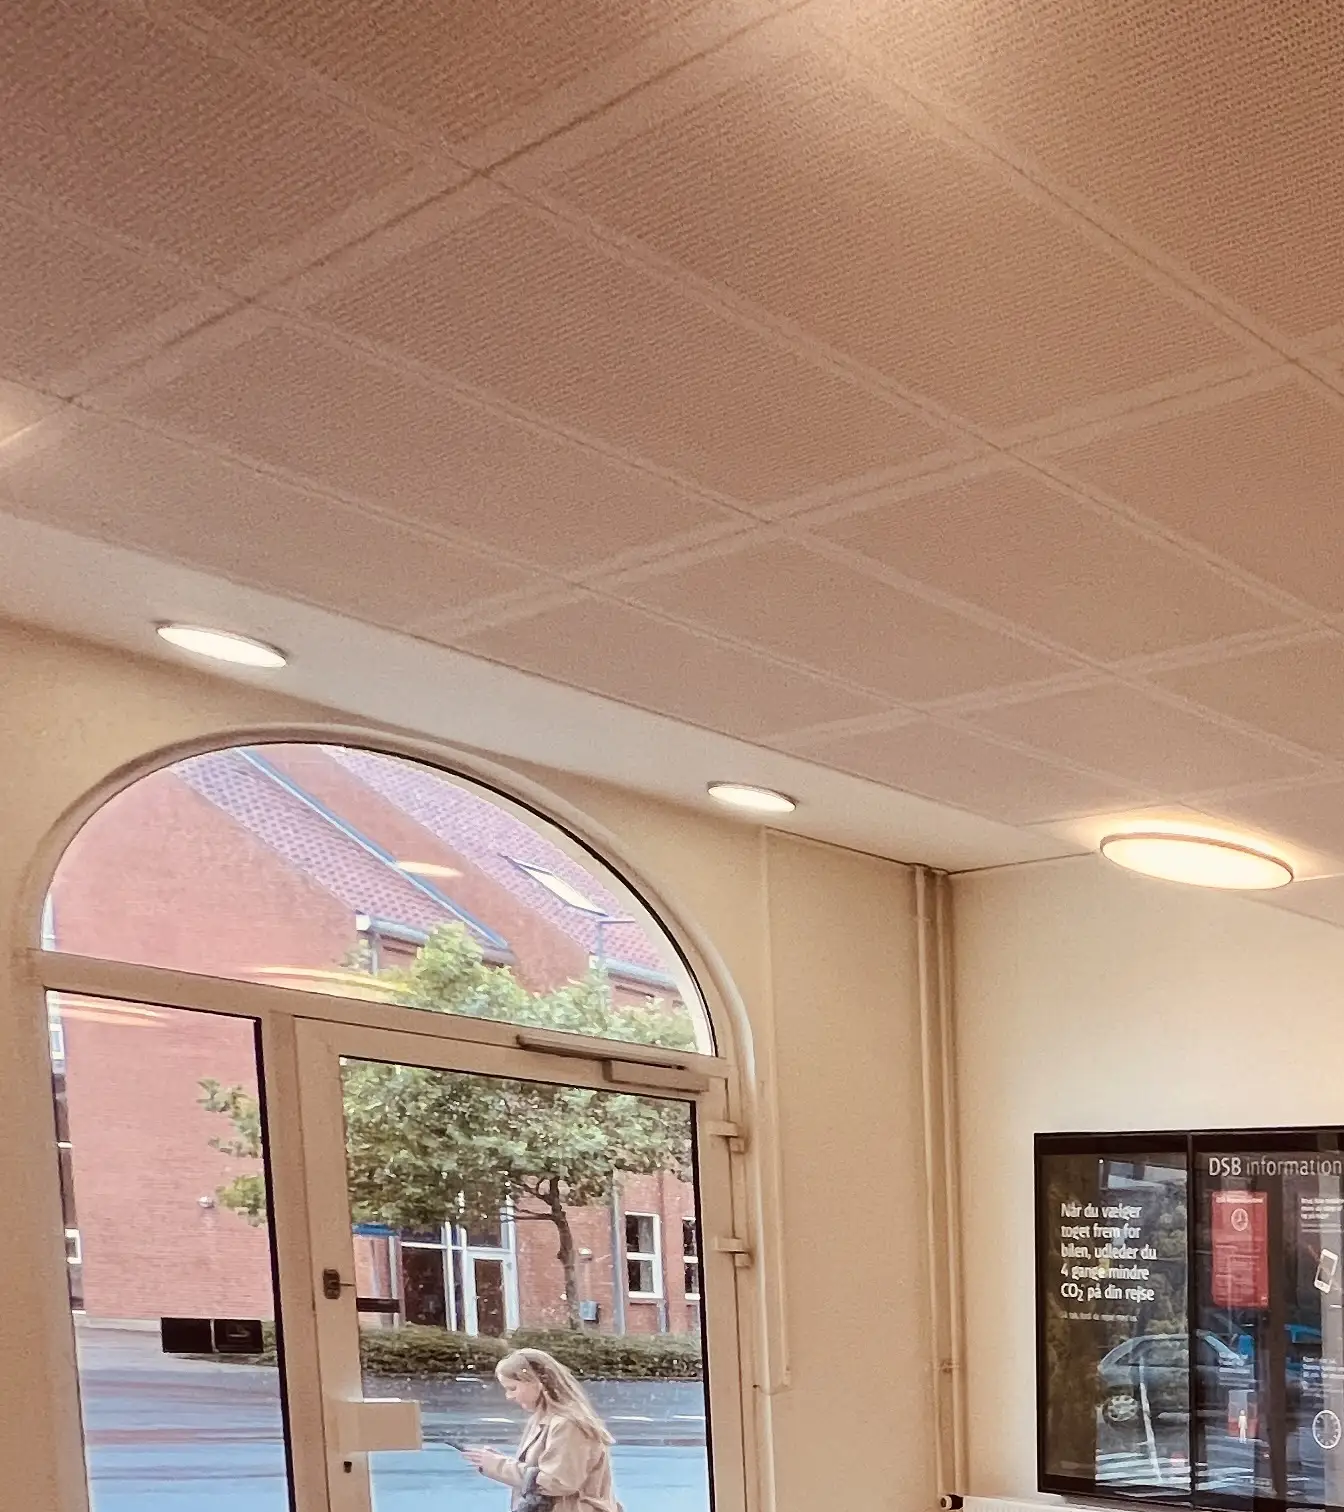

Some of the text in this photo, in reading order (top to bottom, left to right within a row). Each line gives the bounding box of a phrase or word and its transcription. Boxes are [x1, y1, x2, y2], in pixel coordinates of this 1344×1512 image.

[1209, 1155, 1343, 1176] DSB information
[1060, 1202, 1142, 1220] Når du vælger
[1060, 1222, 1141, 1240] toget frem for
[1061, 1243, 1158, 1261] bilen, udleder du
[1060, 1263, 1150, 1281] 4 gange mindre
[1087, 1283, 1102, 1302] på
[1104, 1284, 1123, 1300] din
[1125, 1285, 1155, 1303] rejse
